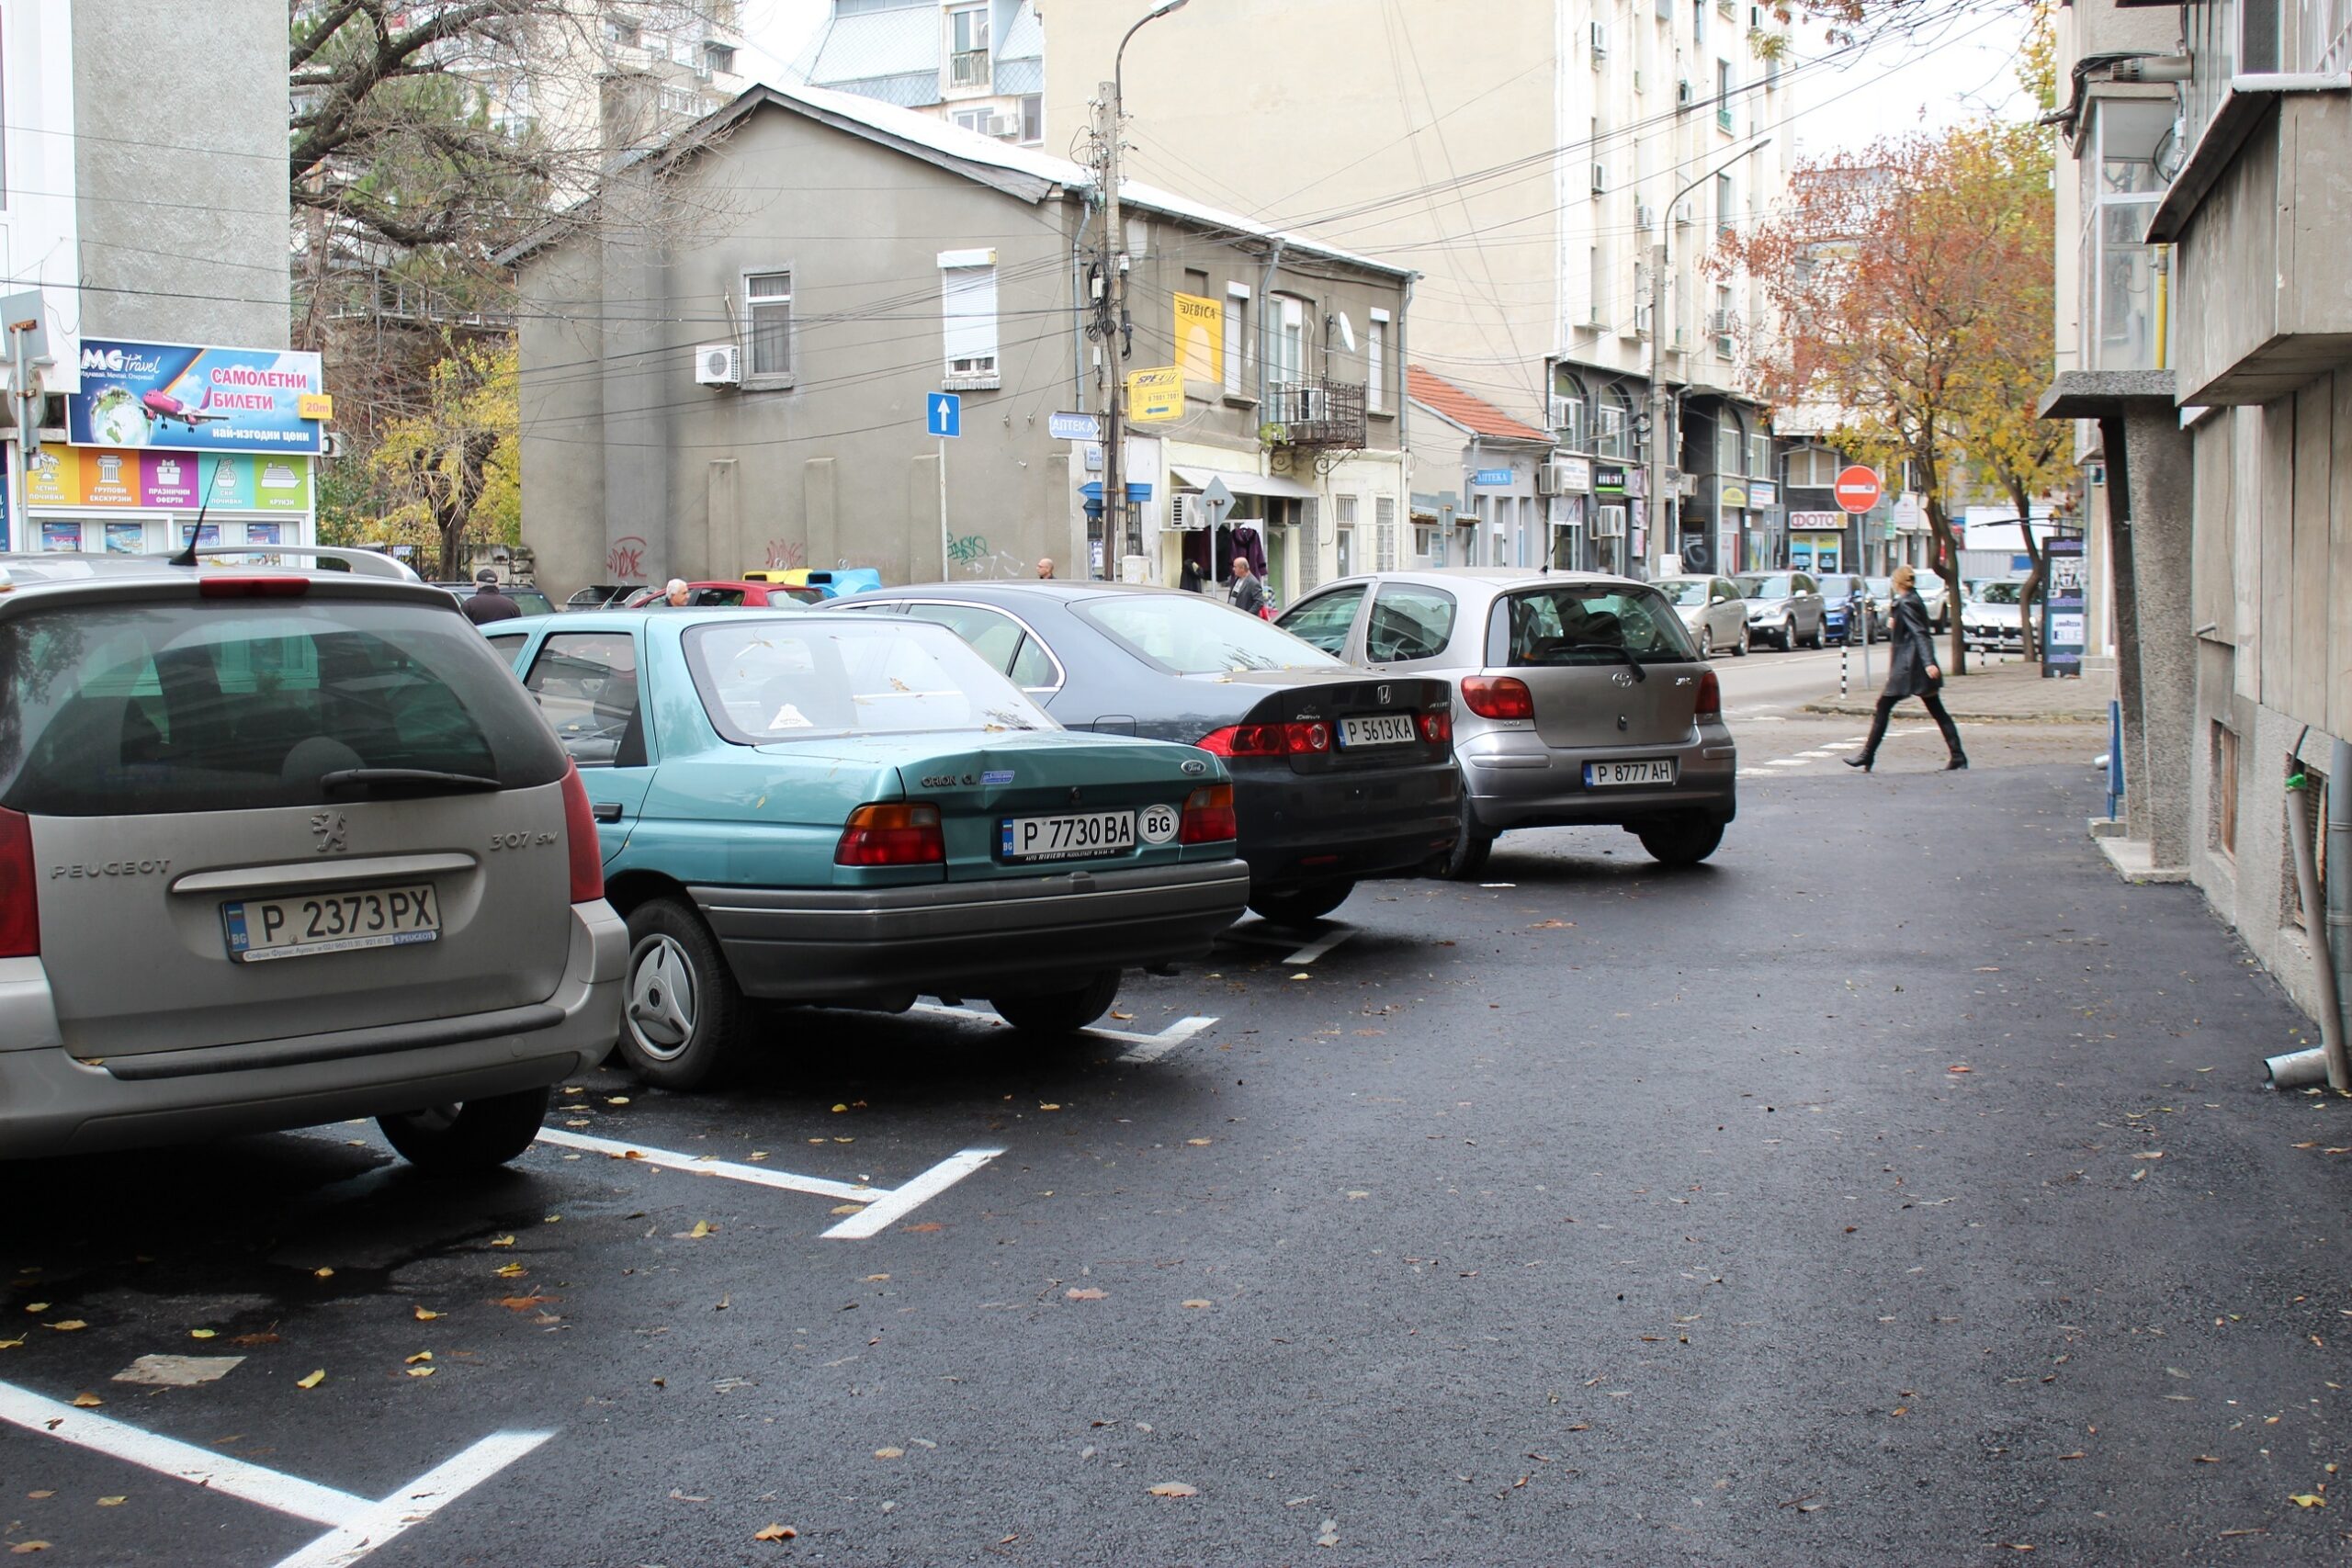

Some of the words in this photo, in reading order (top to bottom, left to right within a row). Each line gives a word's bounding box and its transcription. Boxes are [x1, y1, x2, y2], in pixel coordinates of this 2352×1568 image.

[81, 348, 123, 371] MG
[125, 354, 161, 374] travel
[212, 368, 307, 389] САМОЛЕТНИ
[213, 392, 273, 411] БИЛЕТИ
[306, 402, 329, 412] 20m
[212, 426, 280, 441] най-изгодни
[283, 432, 310, 443] цени
[1052, 419, 1093, 433] АПТЕКА
[89, 494, 132, 502] ЕКСКУРЗИИ
[148, 488, 190, 496] ПРАЗНИЧНИ
[155, 496, 184, 504] ОФЕРТИ
[1791, 513, 1835, 527] ФОТО
[1348, 722, 1357, 742] P
[922, 775, 956, 788] ORION
[1598, 765, 1608, 783] P
[1148, 816, 1170, 833] BG
[489, 830, 531, 851] 307
[1023, 822, 1038, 851] P
[1002, 841, 1013, 852] BG
[51, 859, 171, 879] PEUGEOT
[262, 904, 285, 942] P
[232, 933, 247, 945] BG
[401, 931, 434, 942] PEUGEOT
